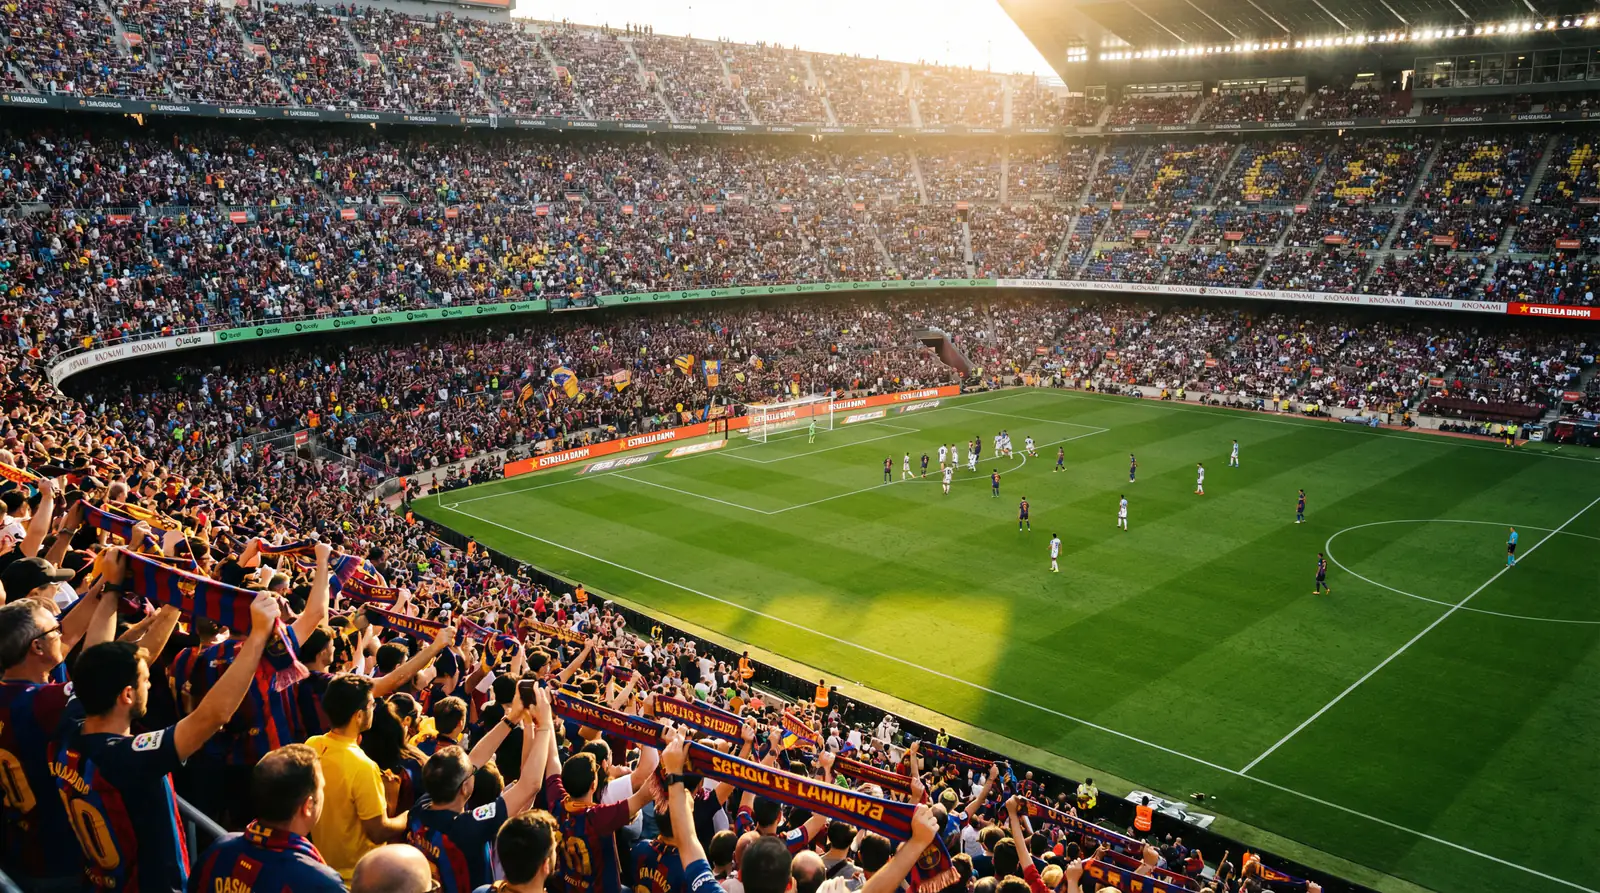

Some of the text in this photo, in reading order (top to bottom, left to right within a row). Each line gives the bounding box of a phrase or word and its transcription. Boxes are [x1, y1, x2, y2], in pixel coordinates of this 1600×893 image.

[1529, 306, 1591, 317] ESTRELLA DAMM
[656, 431, 676, 441] DAMM
[540, 448, 589, 466] ESTRELLA DAMM
